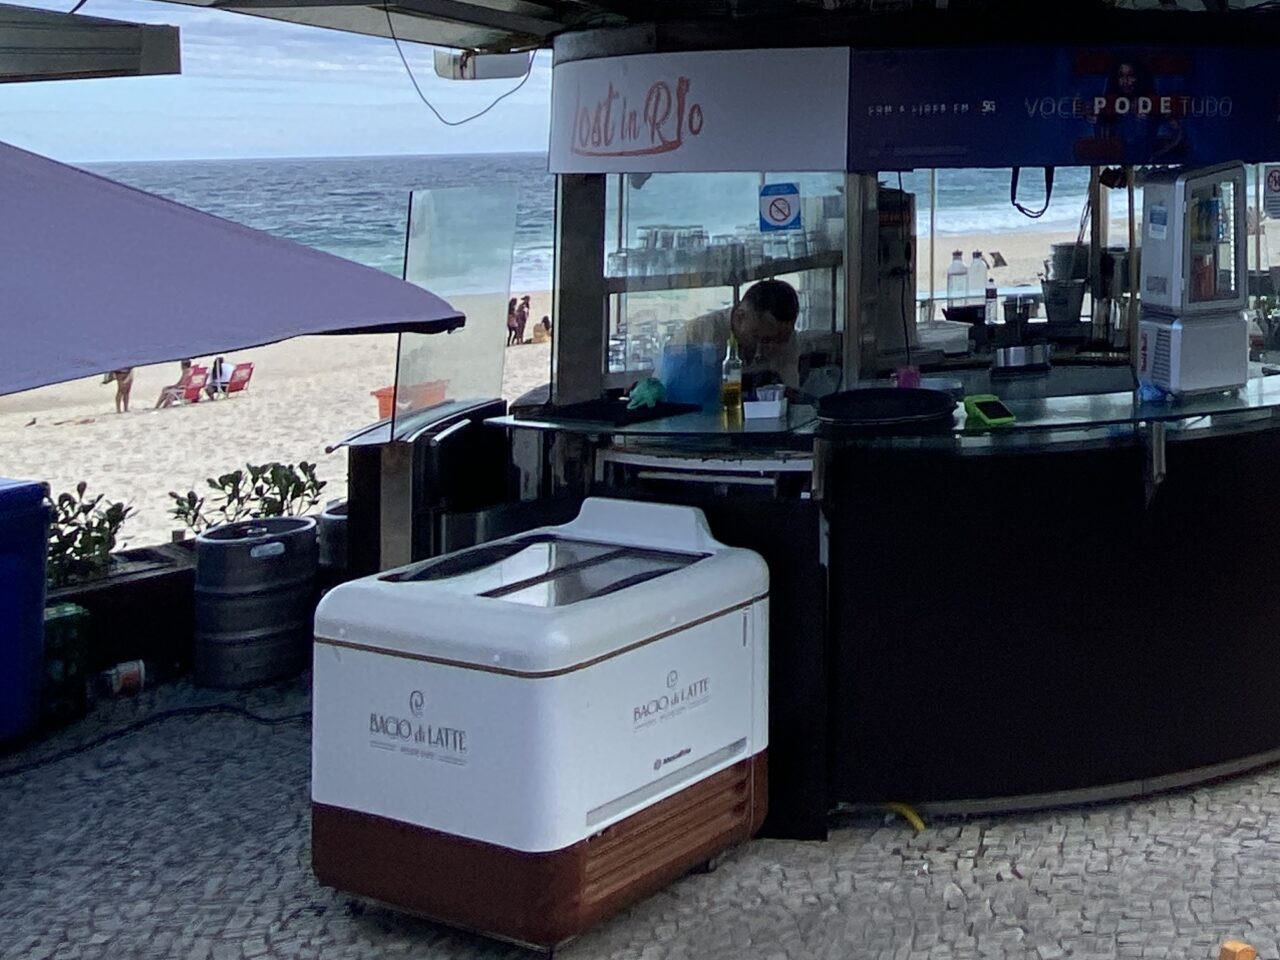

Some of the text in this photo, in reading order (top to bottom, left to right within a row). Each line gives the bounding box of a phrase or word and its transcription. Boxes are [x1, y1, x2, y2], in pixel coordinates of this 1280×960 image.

[620, 96, 641, 142] in
[643, 76, 704, 145] Rio
[981, 100, 996, 113] 5G
[1024, 93, 1233, 119] VOCÊ PODE TUDO
[633, 695, 669, 722] BACIO
[681, 677, 710, 702] LATTE
[369, 712, 412, 739] BACIO
[415, 724, 426, 743] di
[428, 724, 467, 752] LATTE
